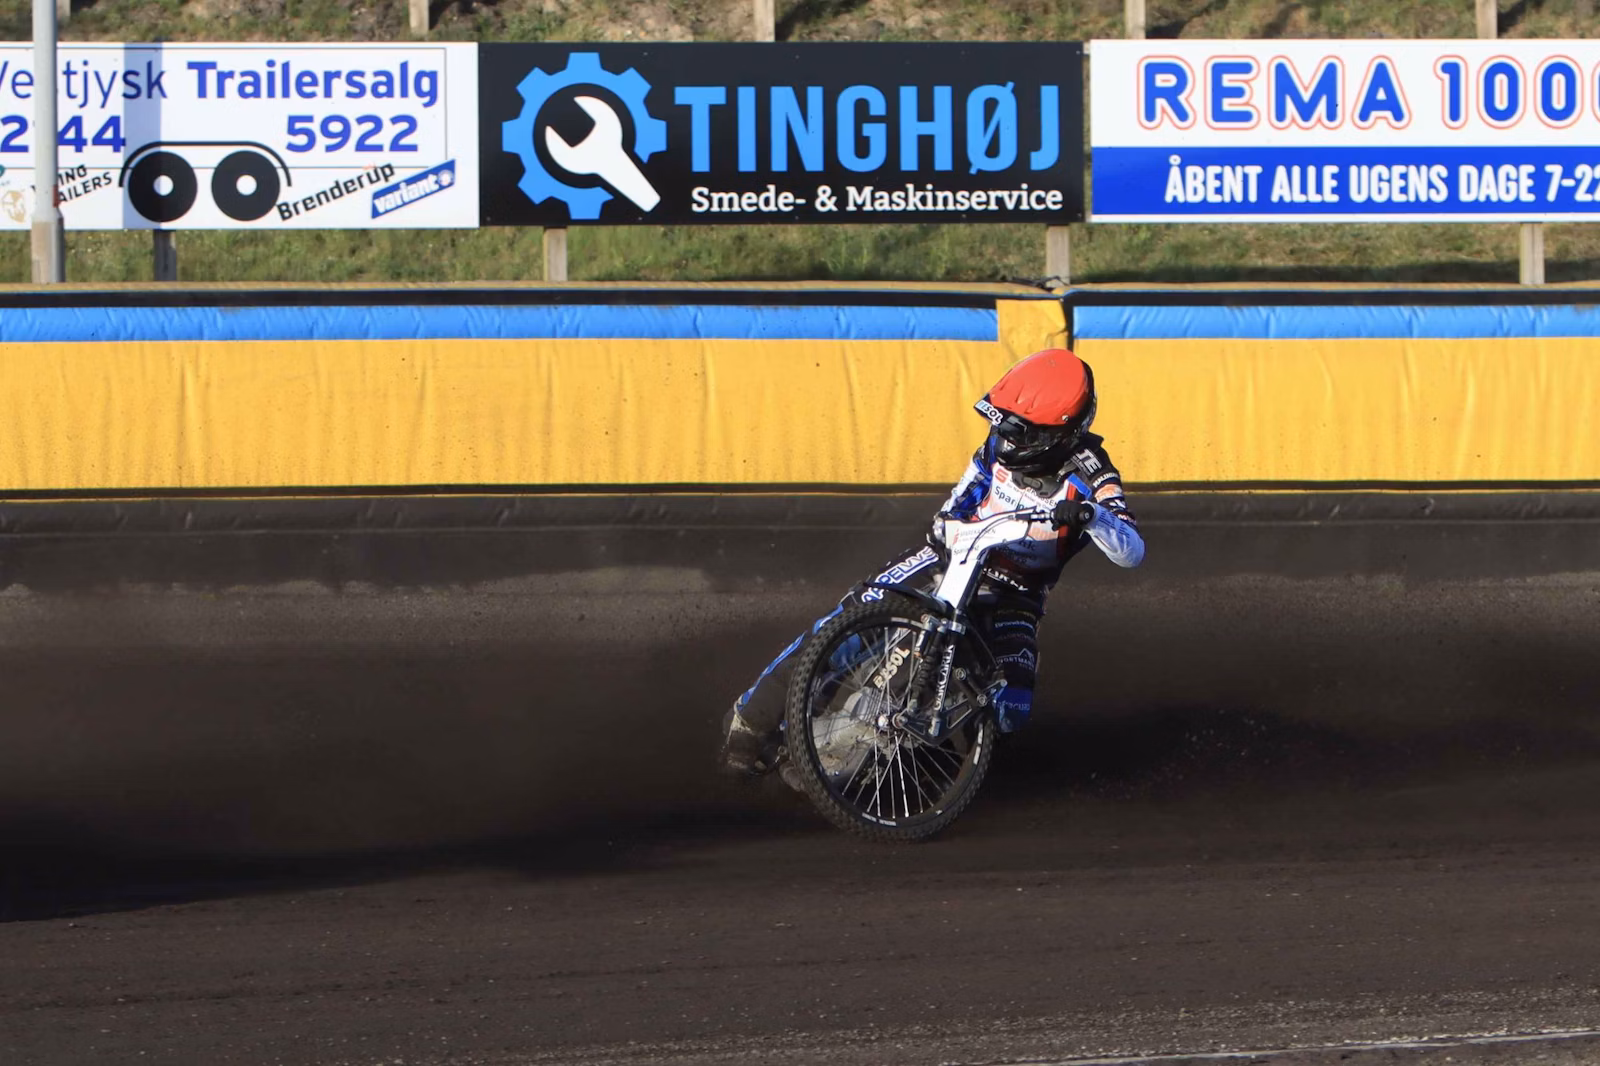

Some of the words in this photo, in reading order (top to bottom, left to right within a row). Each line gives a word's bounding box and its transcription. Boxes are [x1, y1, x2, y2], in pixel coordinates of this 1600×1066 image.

[0, 59, 168, 108] etjysk
[187, 59, 438, 107] Trailersalg
[1137, 55, 1412, 130] REMA
[1434, 55, 1600, 130] 100
[0, 115, 126, 153] 244
[286, 114, 418, 154] 5922
[674, 81, 1060, 175] TINGHØJ
[275, 163, 395, 221] Brenderup
[373, 173, 440, 214] variant
[691, 186, 806, 212] Smede-
[815, 186, 838, 212] &
[846, 186, 1063, 212] Maskinservice
[1164, 155, 1262, 203] ÅBENT
[1271, 164, 1340, 203] ALLE
[1349, 164, 1449, 203] UGENS
[1459, 164, 1536, 203] DAGE
